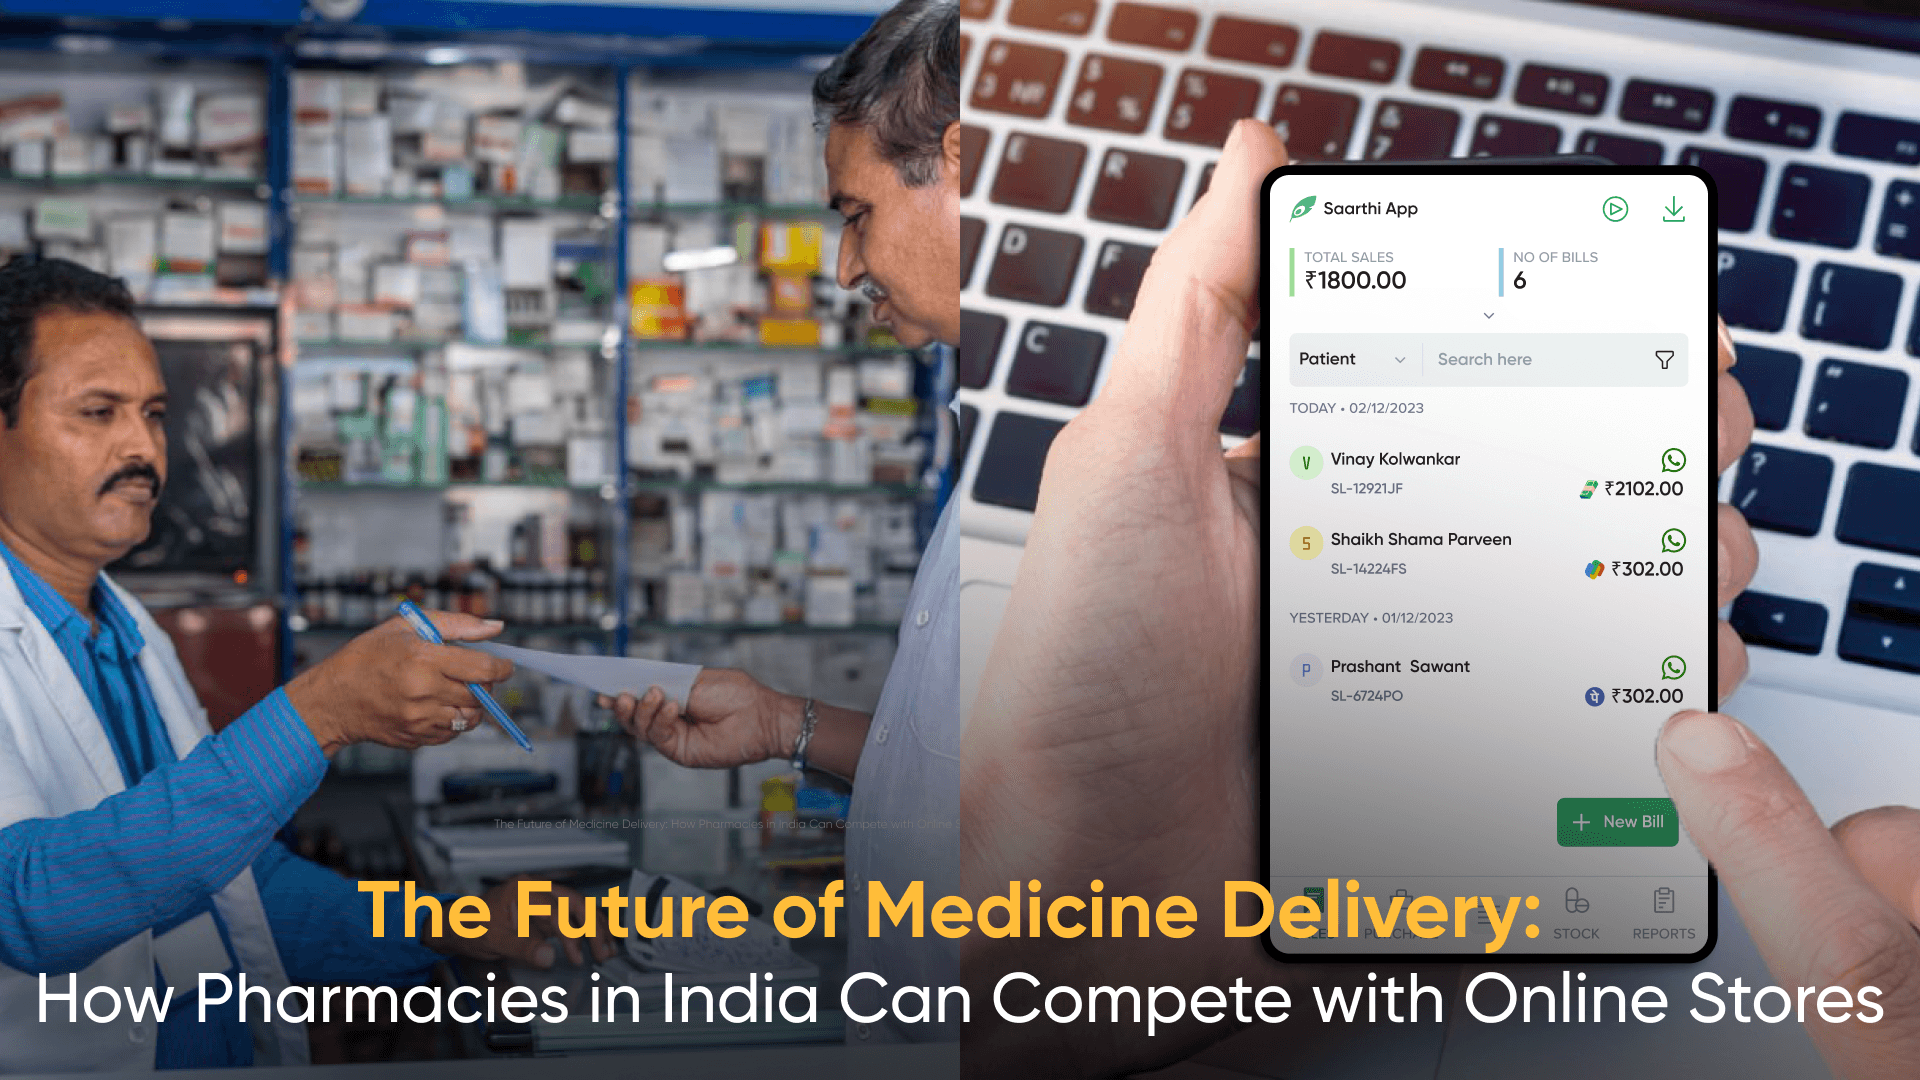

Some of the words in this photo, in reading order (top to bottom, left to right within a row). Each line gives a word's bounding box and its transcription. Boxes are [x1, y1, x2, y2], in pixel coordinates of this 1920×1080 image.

[1007, 136, 1028, 164] E
[1105, 152, 1128, 179] R
[1323, 201, 1382, 216] Saarthi
[1386, 201, 1419, 219] App
[1003, 227, 1028, 255] D
[1101, 244, 1123, 270] F
[1304, 251, 1348, 263] TOTAL
[1351, 251, 1394, 263] SALES
[1513, 251, 1535, 263] NO
[1538, 251, 1558, 263] OF
[1562, 251, 1599, 263] BILLS
[1305, 270, 1407, 290] ₹1800.00
[1513, 270, 1527, 290] 6
[1025, 326, 1050, 352] C
[1299, 351, 1356, 366] Patient
[1437, 352, 1493, 366] Search
[1497, 352, 1533, 366] here
[1289, 402, 1337, 414] TODAY
[1349, 402, 1424, 414] 02/12/2023
[1302, 455, 1311, 471] V
[1330, 451, 1376, 469] Vinay
[1379, 451, 1461, 466] Kolwankar
[1330, 482, 1404, 495] SL-12921JF
[1604, 480, 1684, 497] ₹2102.00
[1330, 532, 1384, 546] Shaikh
[1387, 532, 1444, 546] Shama
[1448, 532, 1512, 546] Parveen
[1330, 562, 1407, 575] SL-14224FS
[1611, 560, 1684, 577] ₹302.00
[1289, 612, 1370, 624] YESTERDAY
[1381, 612, 1454, 624] 01/12/2023
[1302, 663, 1311, 678] P
[1331, 659, 1402, 673] Prashant
[1409, 659, 1471, 673] Sawant
[1330, 689, 1404, 702] SL-6724PO
[1611, 688, 1684, 704] ₹302.00
[1604, 814, 1638, 829] New
[1642, 814, 1664, 829] Bill
[1553, 928, 1600, 940] STOCK
[1633, 928, 1696, 940] REPORTS
